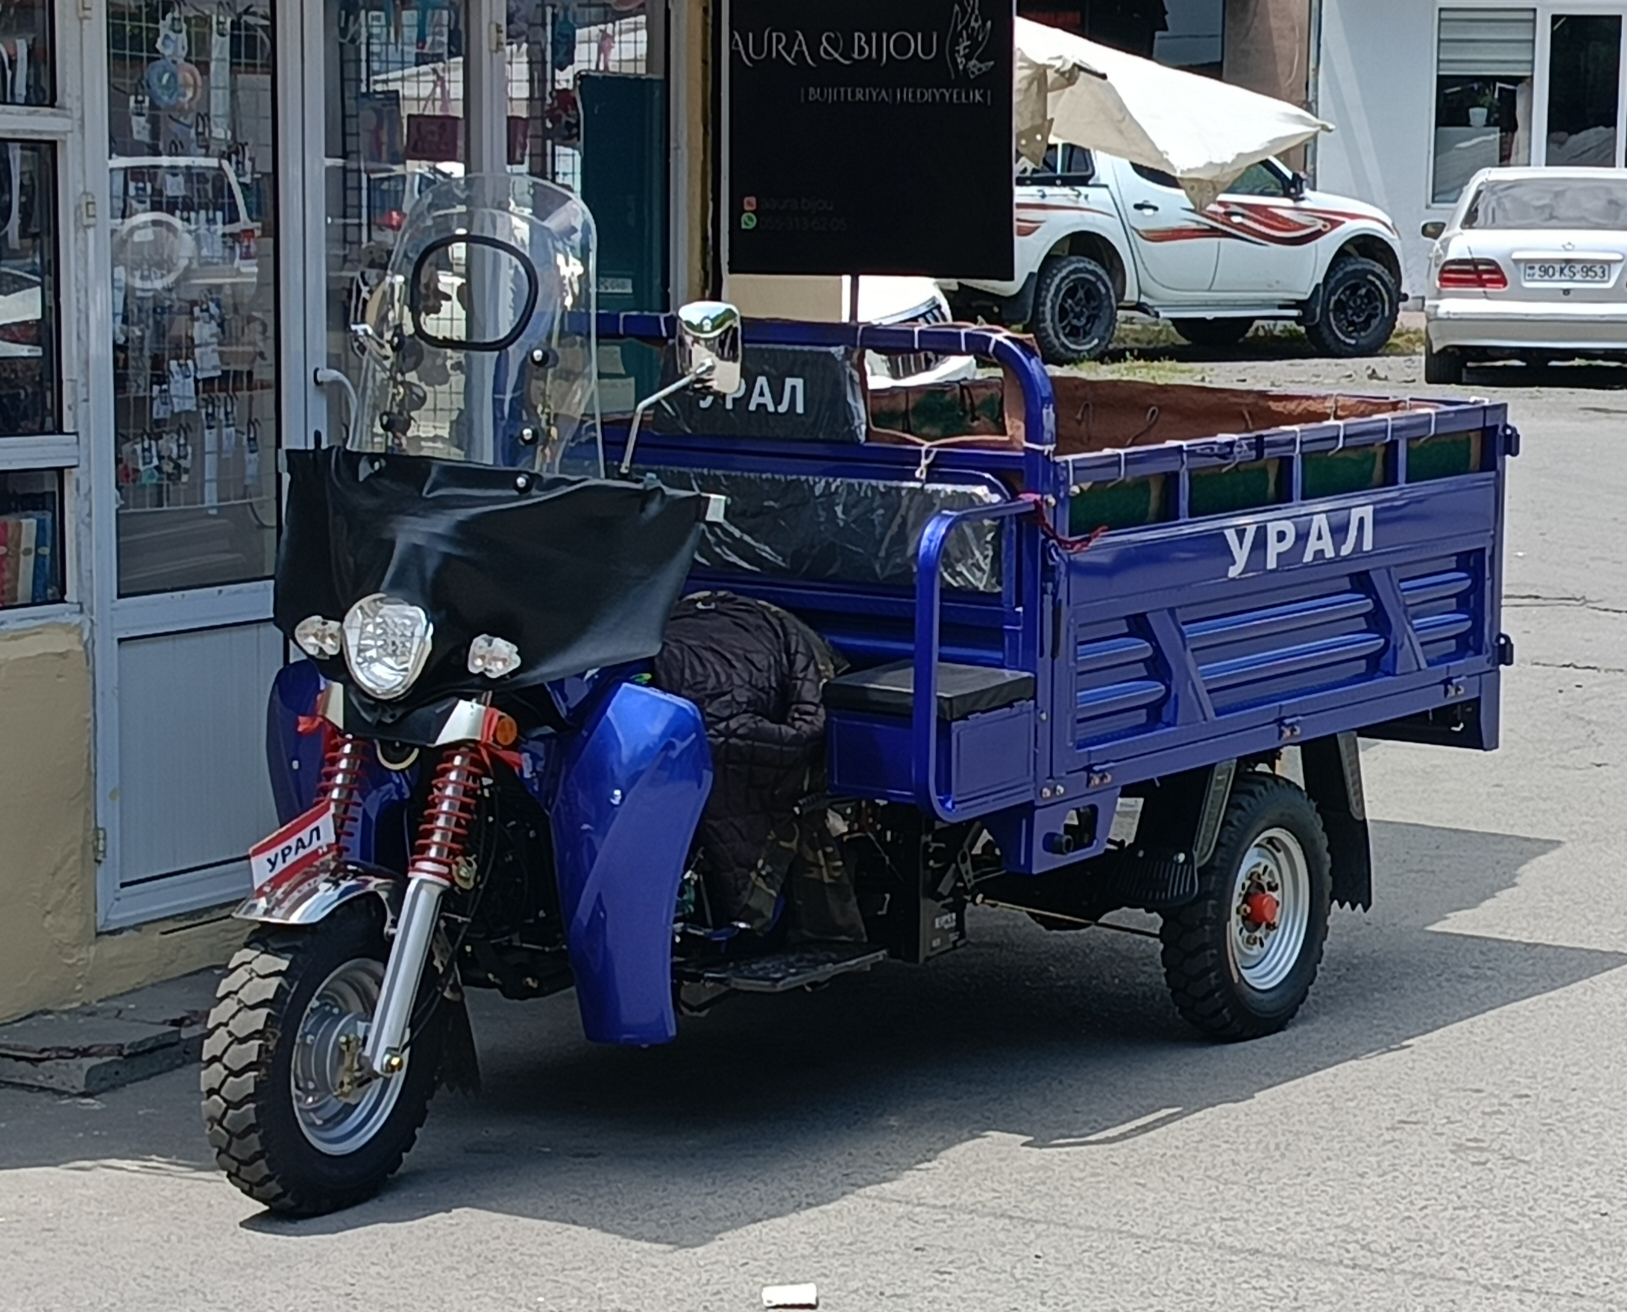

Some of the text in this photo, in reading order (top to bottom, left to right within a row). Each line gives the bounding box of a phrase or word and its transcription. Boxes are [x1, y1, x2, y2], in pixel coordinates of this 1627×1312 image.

[731, 26, 938, 67] AURA & BIJOU
[1223, 505, 1374, 578] УРАЛ
[266, 826, 321, 873] УРАЛ
